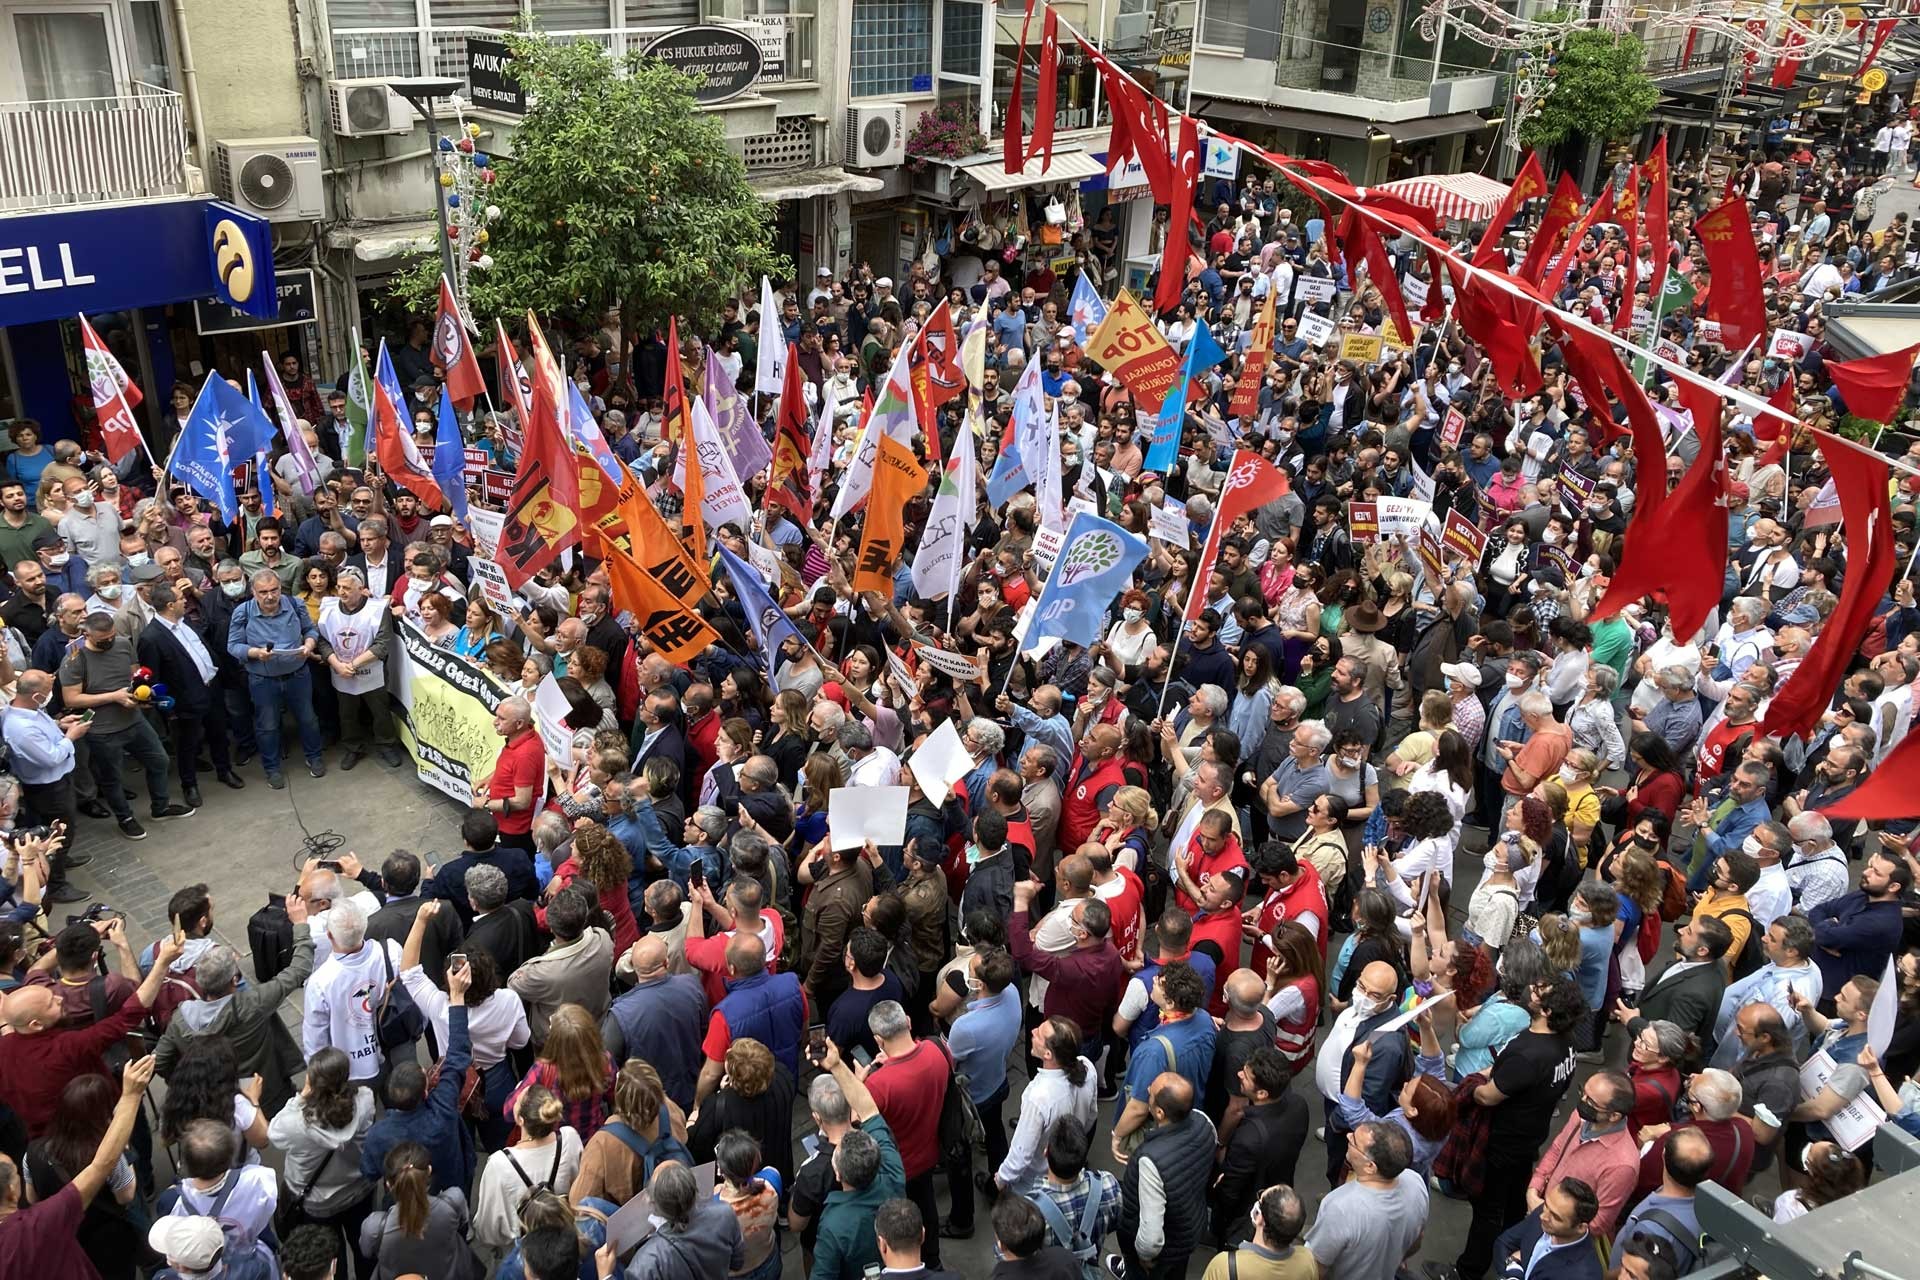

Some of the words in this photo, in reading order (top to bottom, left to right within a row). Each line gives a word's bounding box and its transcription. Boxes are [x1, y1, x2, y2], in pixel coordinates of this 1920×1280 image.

[675, 46, 707, 58] HUKUK
[708, 42, 743, 57] BÜROSU
[756, 74, 783, 83] ANDAN
[285, 150, 317, 159] SAMSUNG
[1040, 531, 1059, 545] GEZİ
[419, 754, 442, 776] Emek
